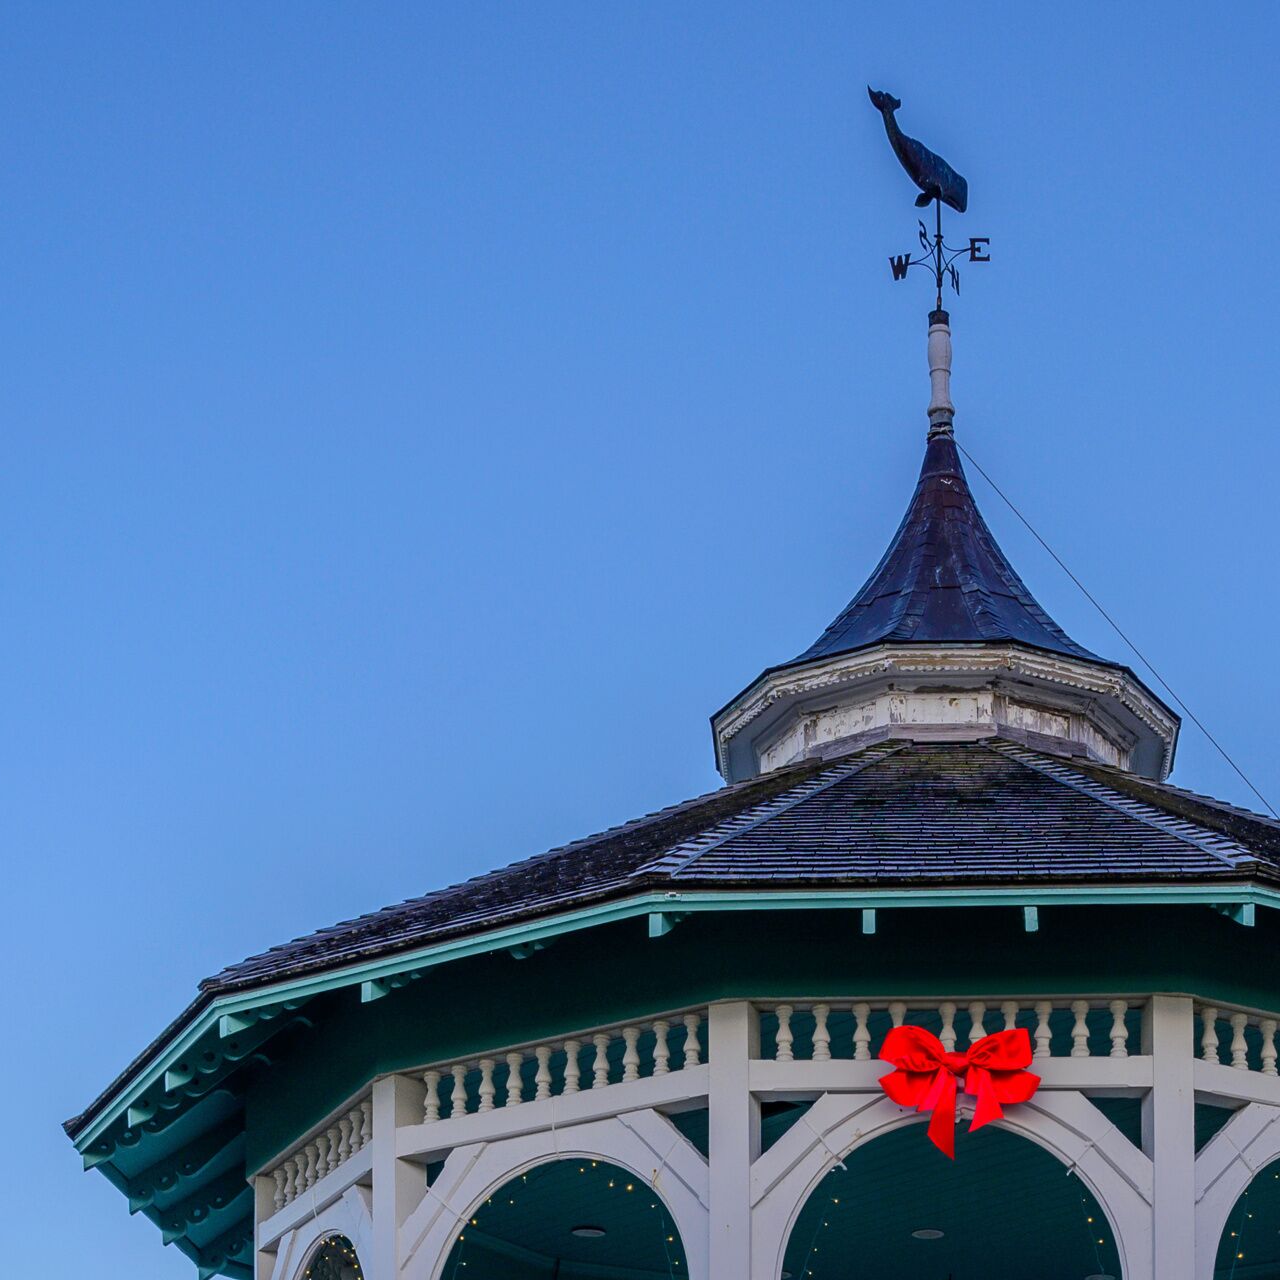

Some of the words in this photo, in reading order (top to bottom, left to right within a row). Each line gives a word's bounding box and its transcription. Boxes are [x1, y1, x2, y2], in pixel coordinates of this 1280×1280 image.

[969, 237, 990, 262] E
[888, 252, 912, 281] W
[950, 263, 960, 296] N
